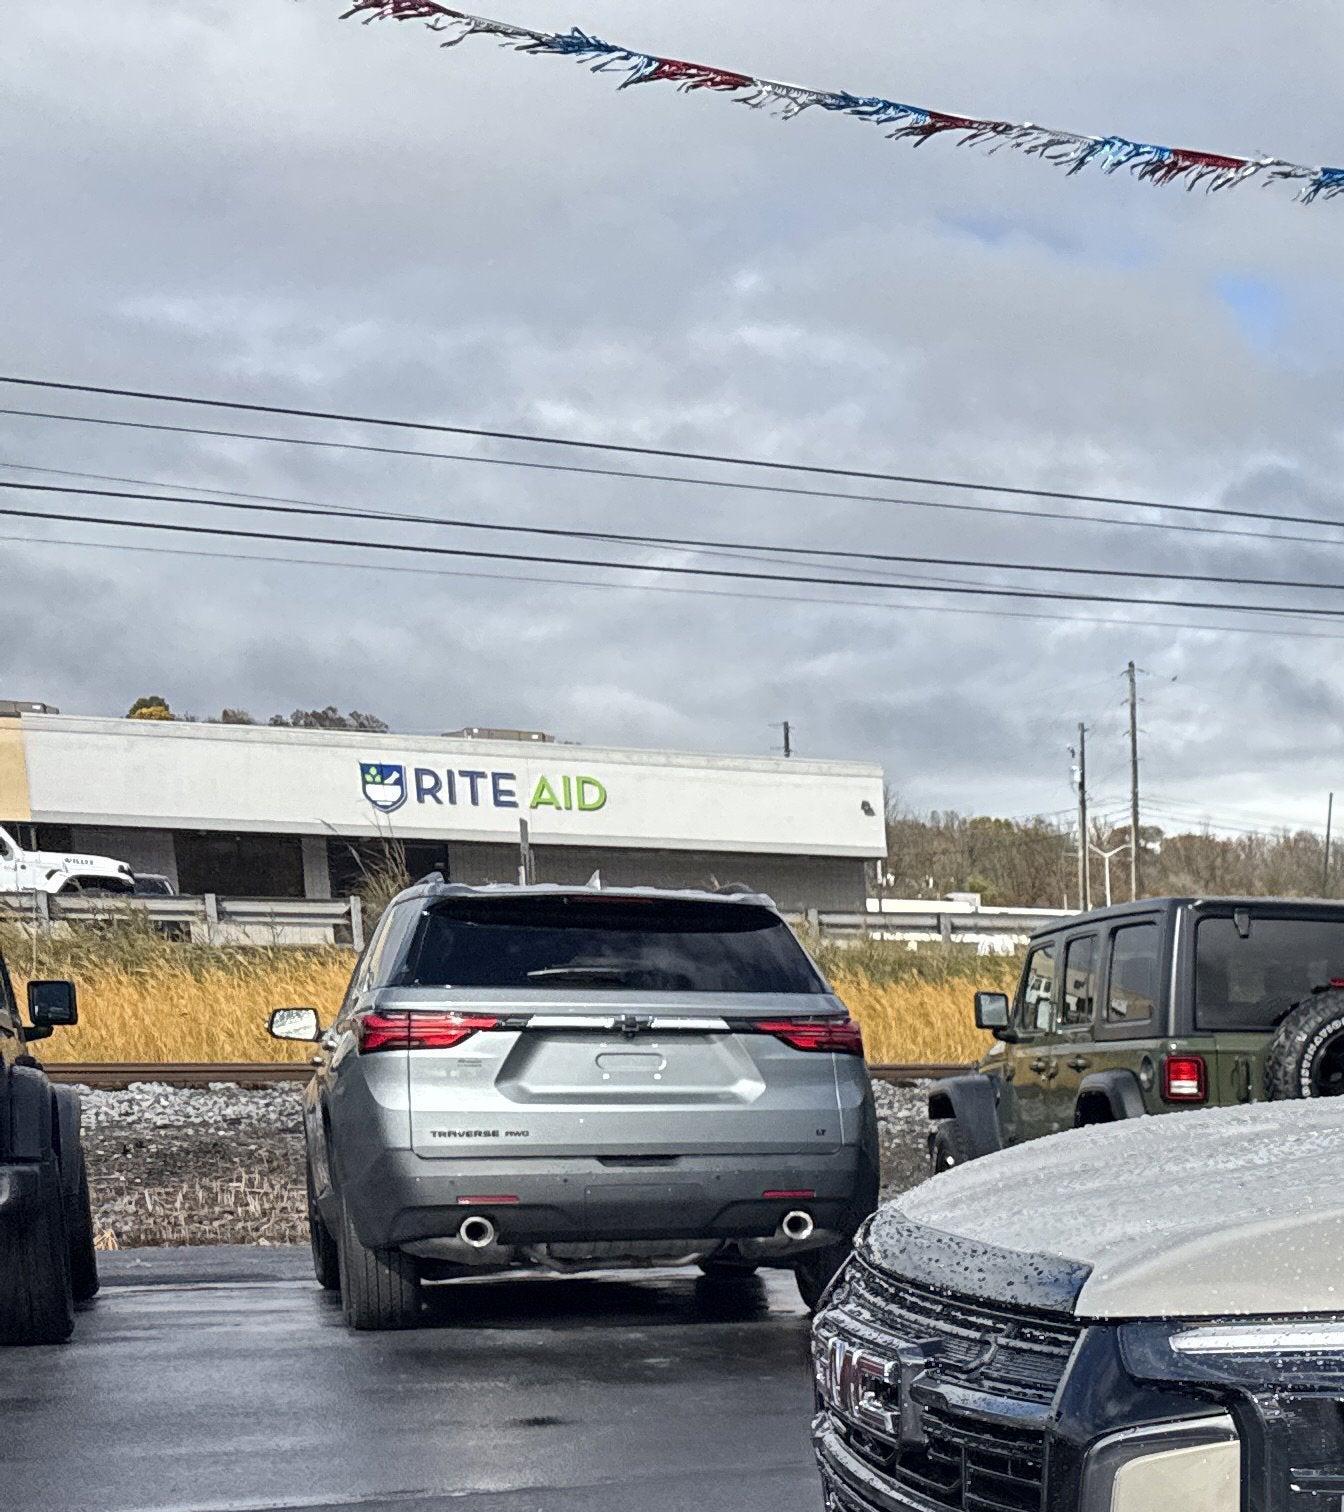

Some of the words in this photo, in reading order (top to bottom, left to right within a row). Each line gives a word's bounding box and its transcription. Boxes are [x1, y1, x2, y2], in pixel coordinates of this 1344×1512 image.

[414, 767, 519, 808] RITE
[529, 775, 607, 811] AID
[430, 1129, 500, 1138] TRAVERSE
